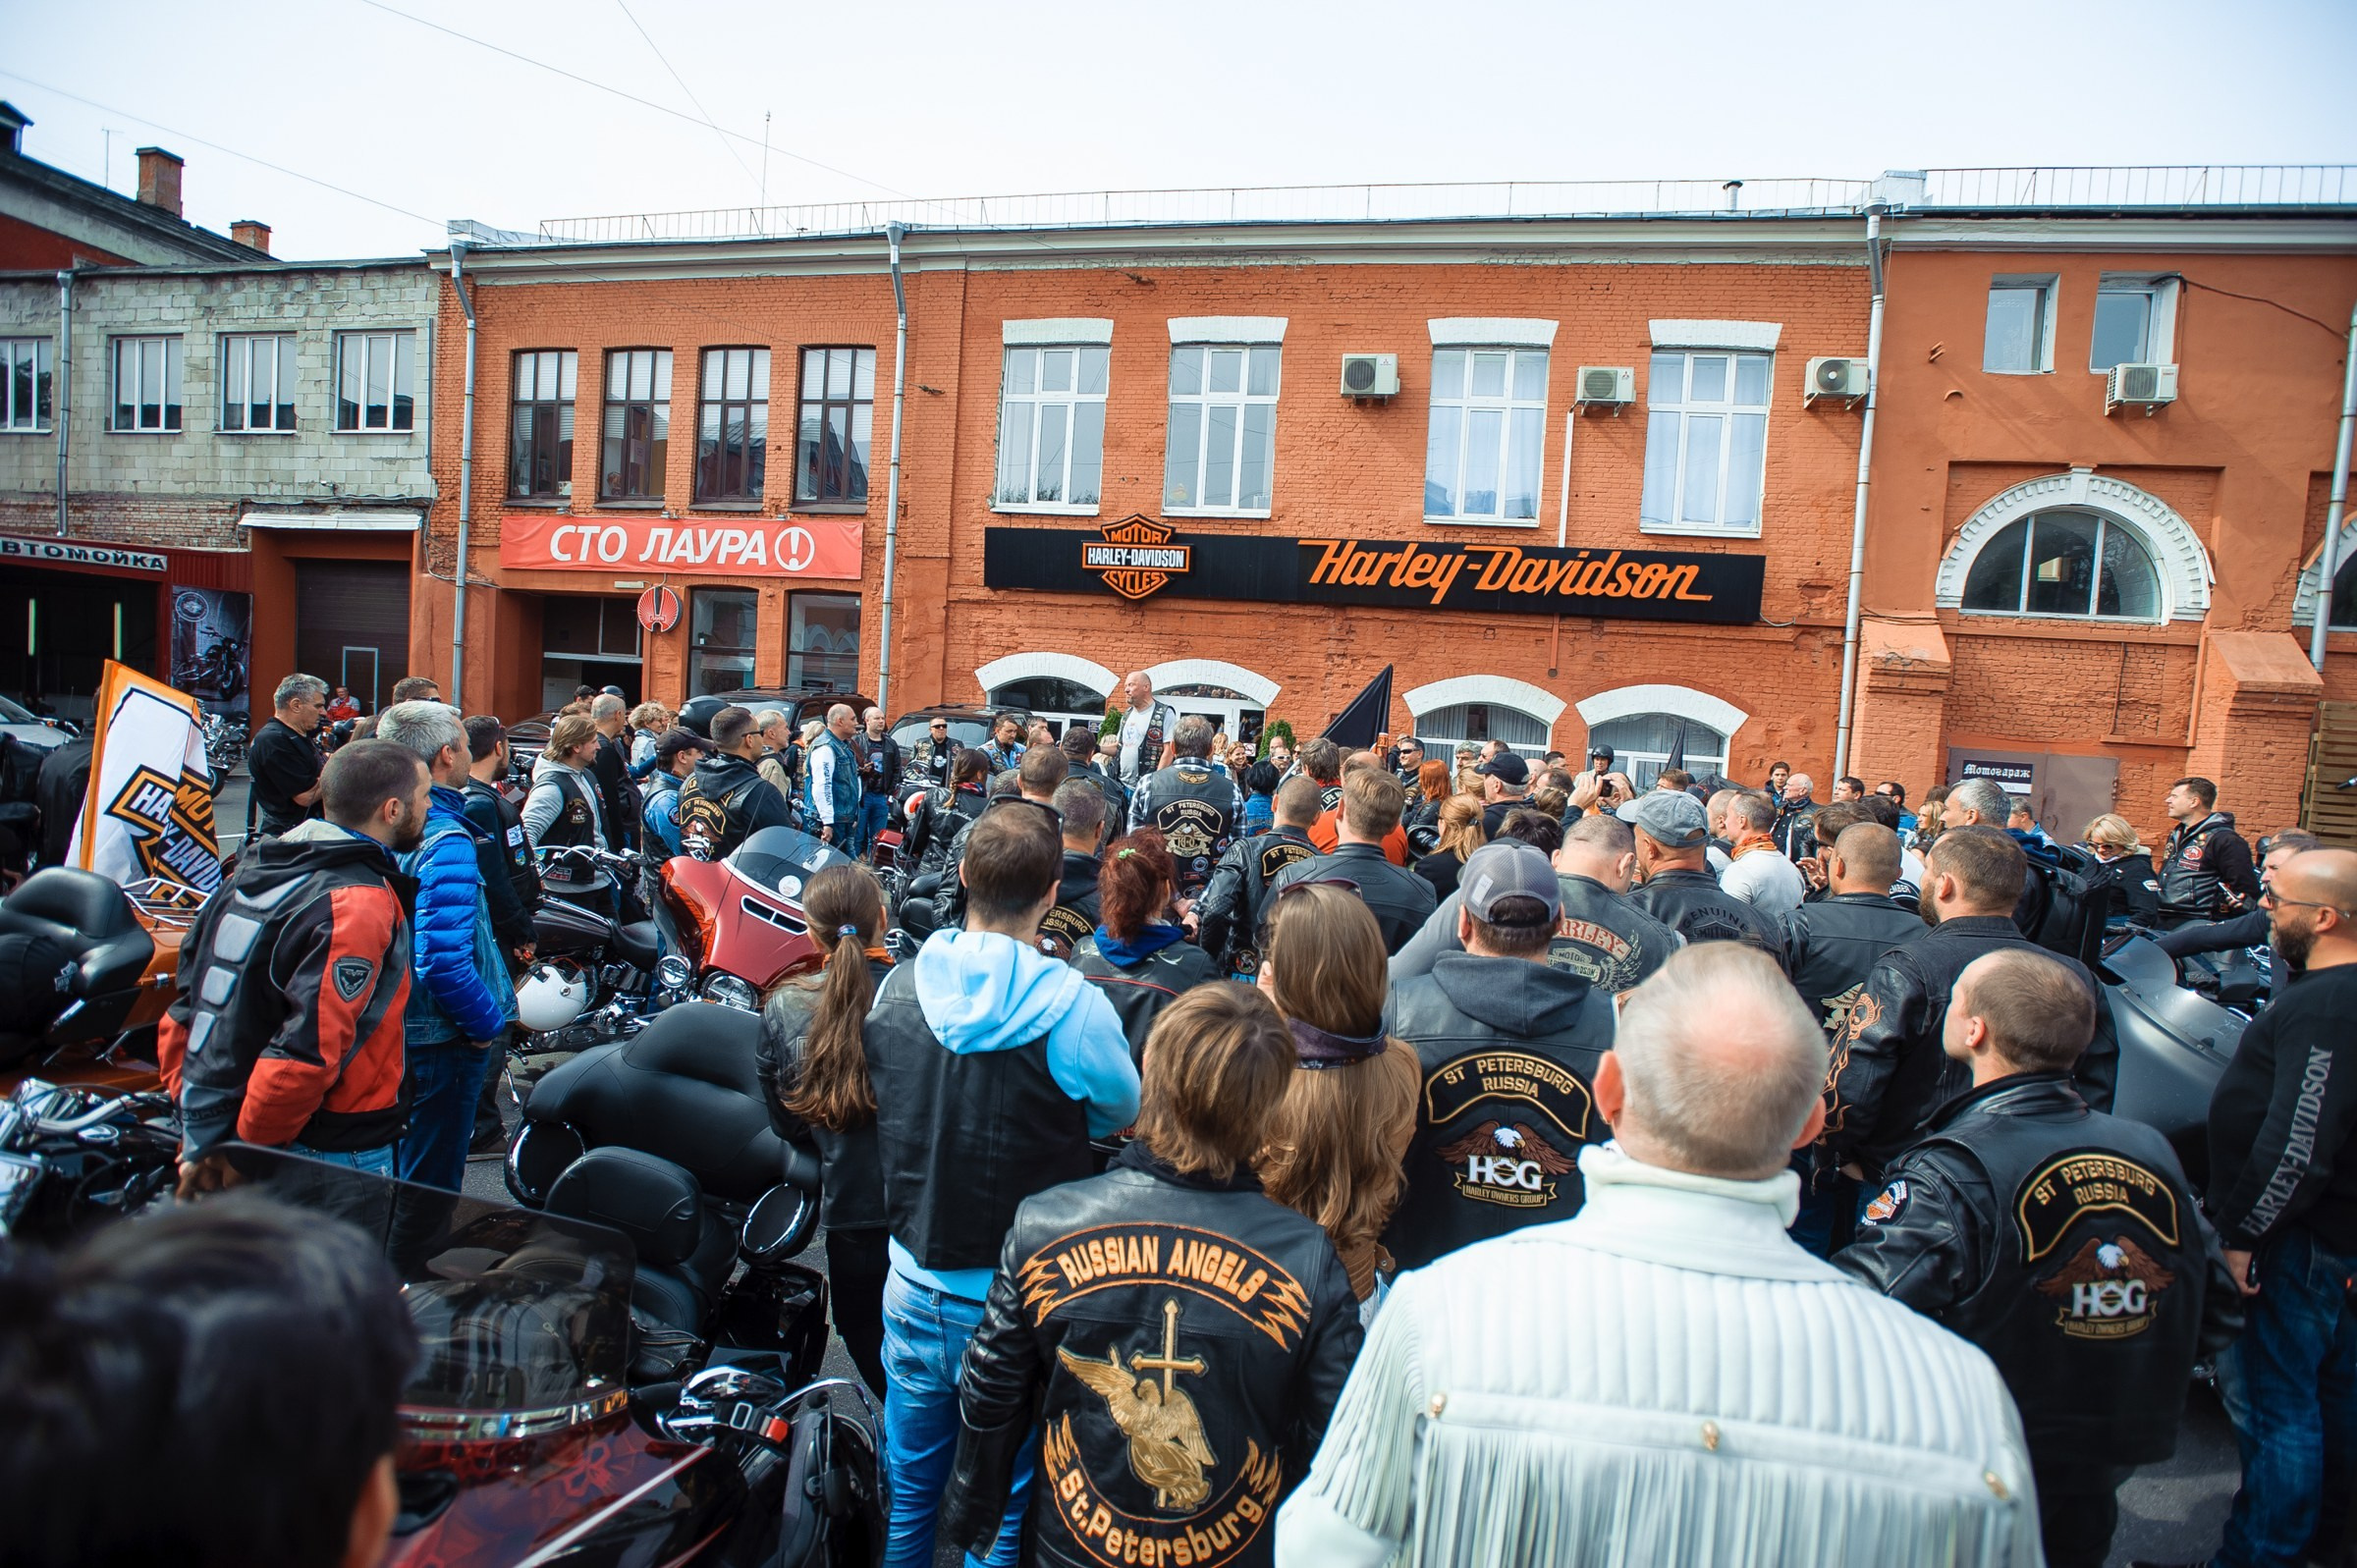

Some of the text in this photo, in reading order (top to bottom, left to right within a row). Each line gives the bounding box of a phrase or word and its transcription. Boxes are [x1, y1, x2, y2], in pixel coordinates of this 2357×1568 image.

[549, 524, 767, 567] СТО ЛАУРА
[1111, 523, 1163, 543] MOTOR
[0, 540, 165, 571] ВТОМОЙКА
[1087, 546, 1184, 568] HARLEY-DAVIDSON
[1109, 569, 1166, 595] CYCLES
[1296, 539, 1714, 605] Harley-Davidson
[1963, 762, 2032, 780] Мотогараж
[1322, 793, 1337, 805] LIFE
[1270, 849, 1280, 858] ST
[1049, 909, 1088, 933] ERSBURG
[1682, 906, 1749, 933] GENUINE
[1444, 1057, 1574, 1095] ST PETERSBURG
[1481, 1076, 1539, 1098] RUSSIA
[2238, 1045, 2332, 1237] HARLEY-DAVIDSON
[1467, 1155, 1542, 1190] HOG
[2034, 1161, 2157, 1206] ST PETERSBURG
[1465, 1186, 1544, 1204] HARLEY OWNERS GROUP
[2073, 1182, 2130, 1205] RUSSIA
[1057, 1235, 1269, 1303] RUSSIAN ANGELS
[2071, 1279, 2148, 1318] HOG
